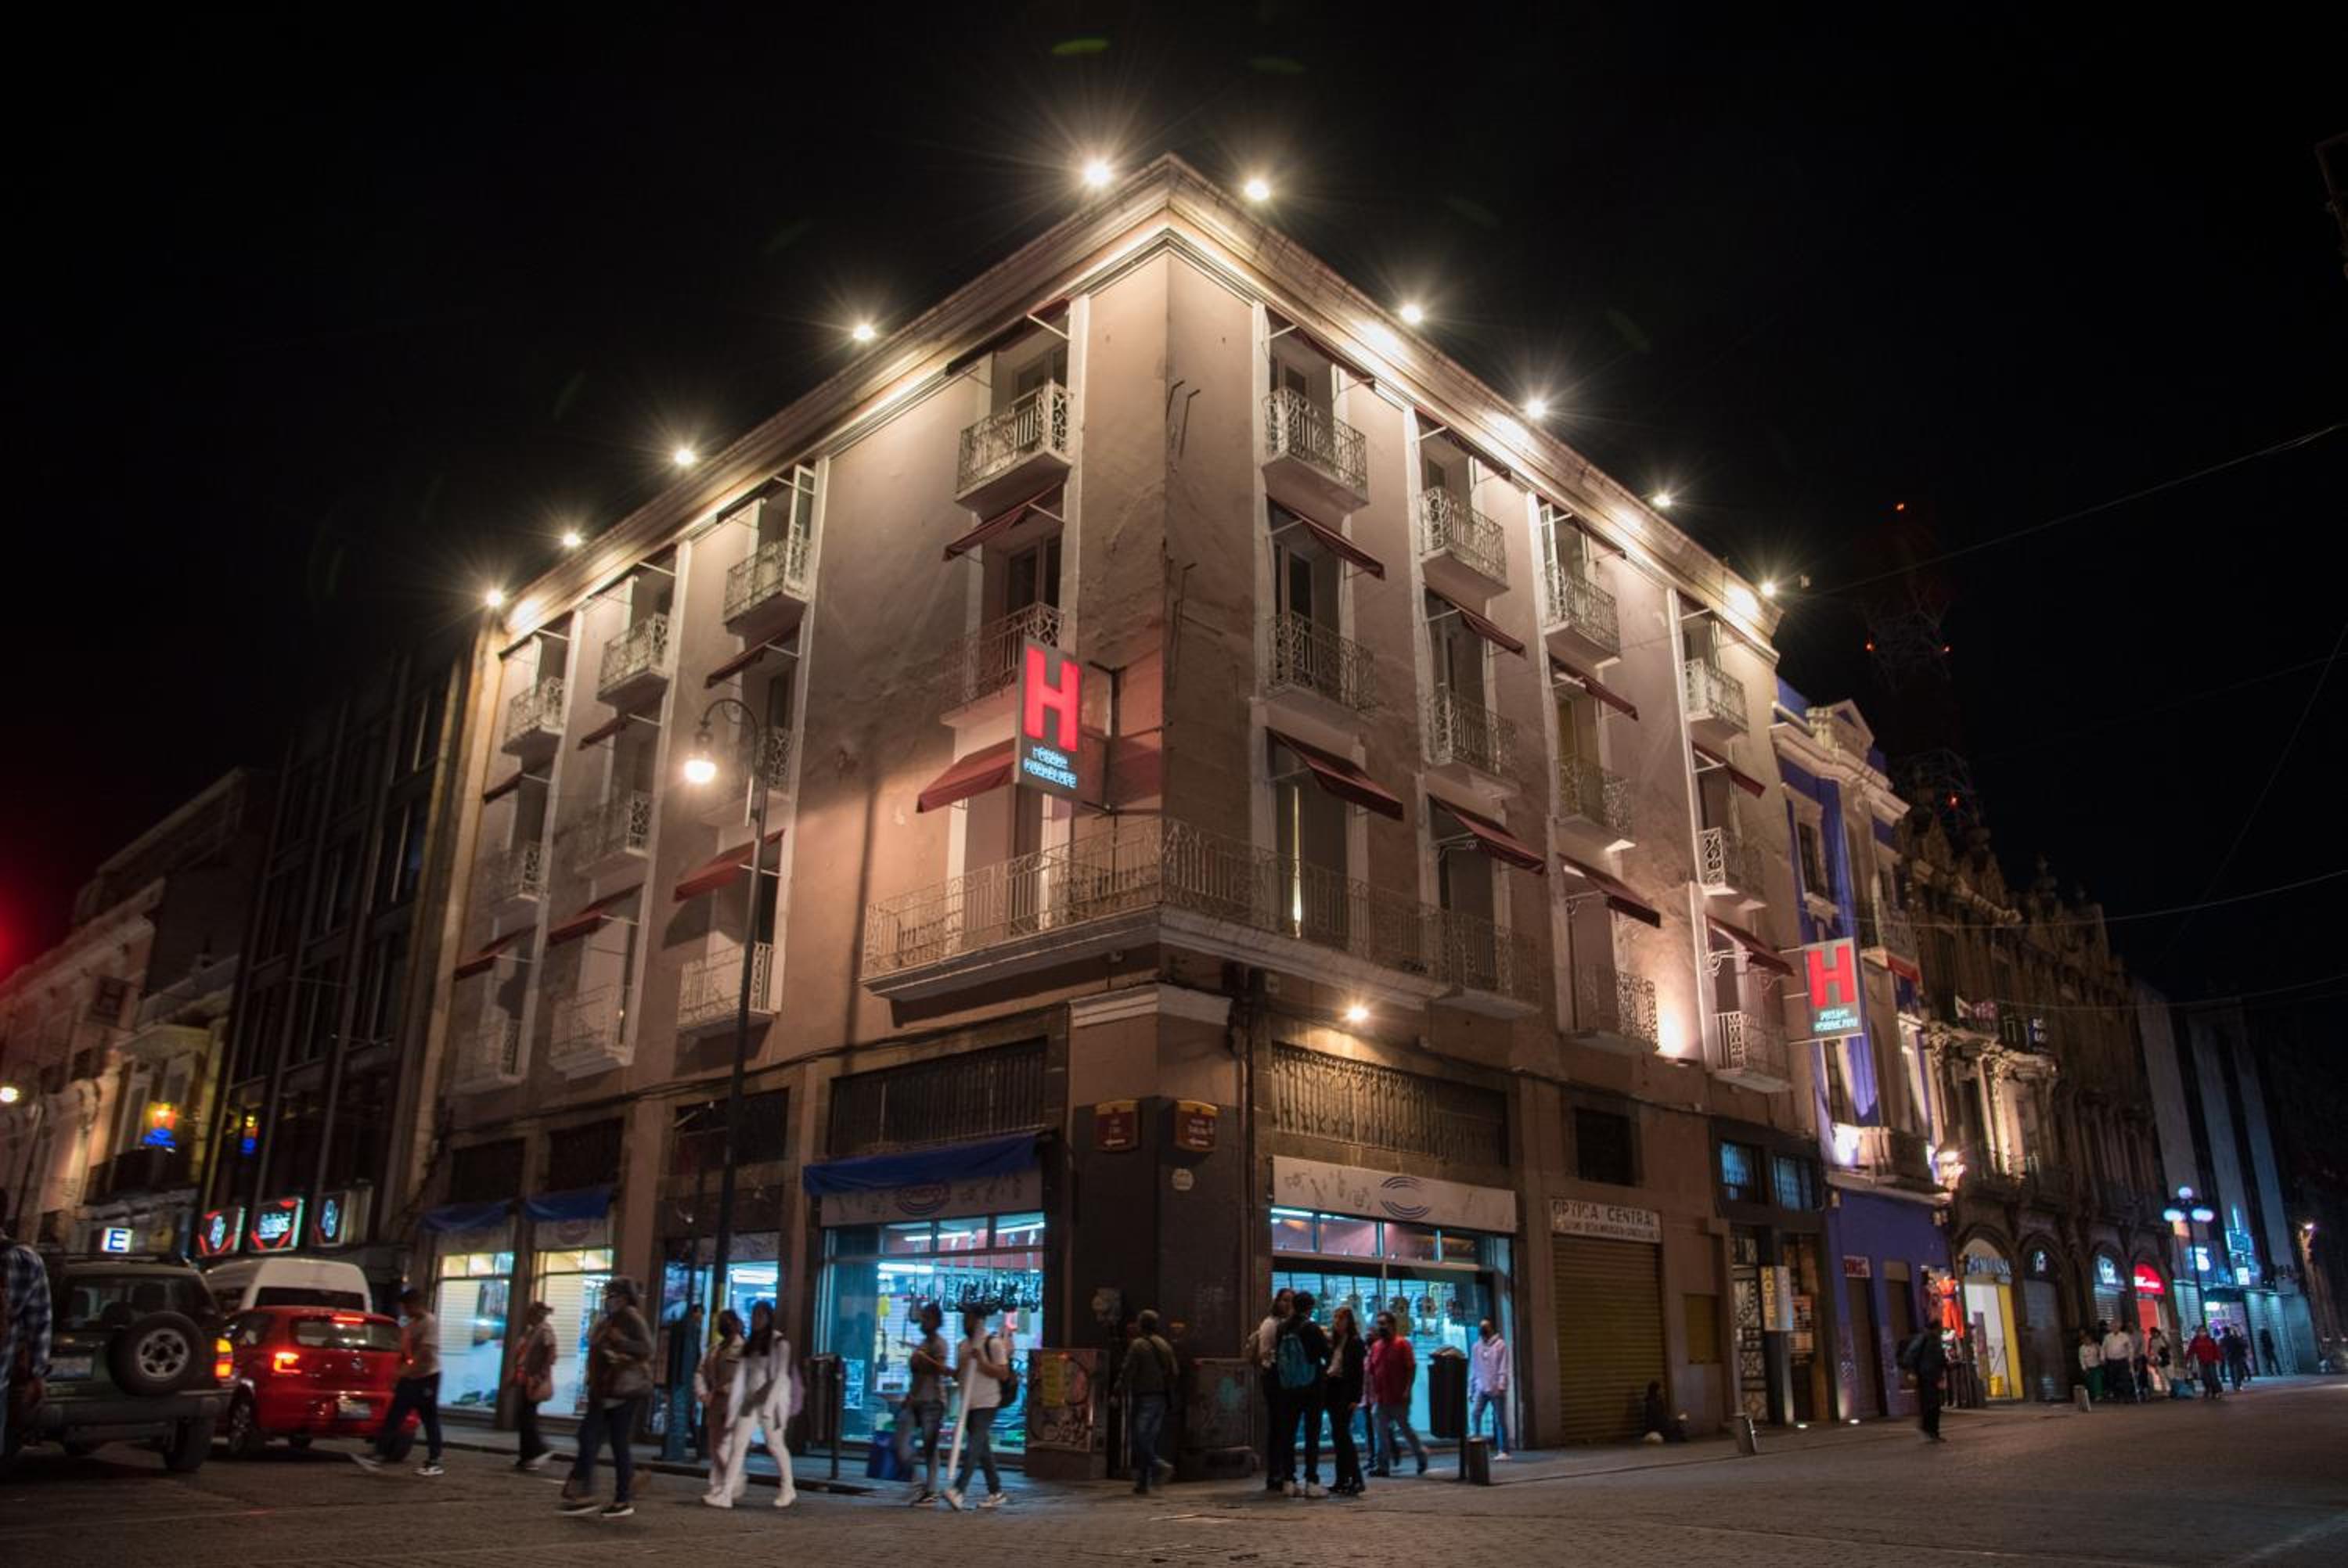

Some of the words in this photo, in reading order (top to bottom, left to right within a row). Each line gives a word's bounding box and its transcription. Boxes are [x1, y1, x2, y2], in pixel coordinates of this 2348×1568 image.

[1025, 646, 1080, 751] H
[1808, 946, 1856, 1007] H
[108, 1229, 126, 1250] E
